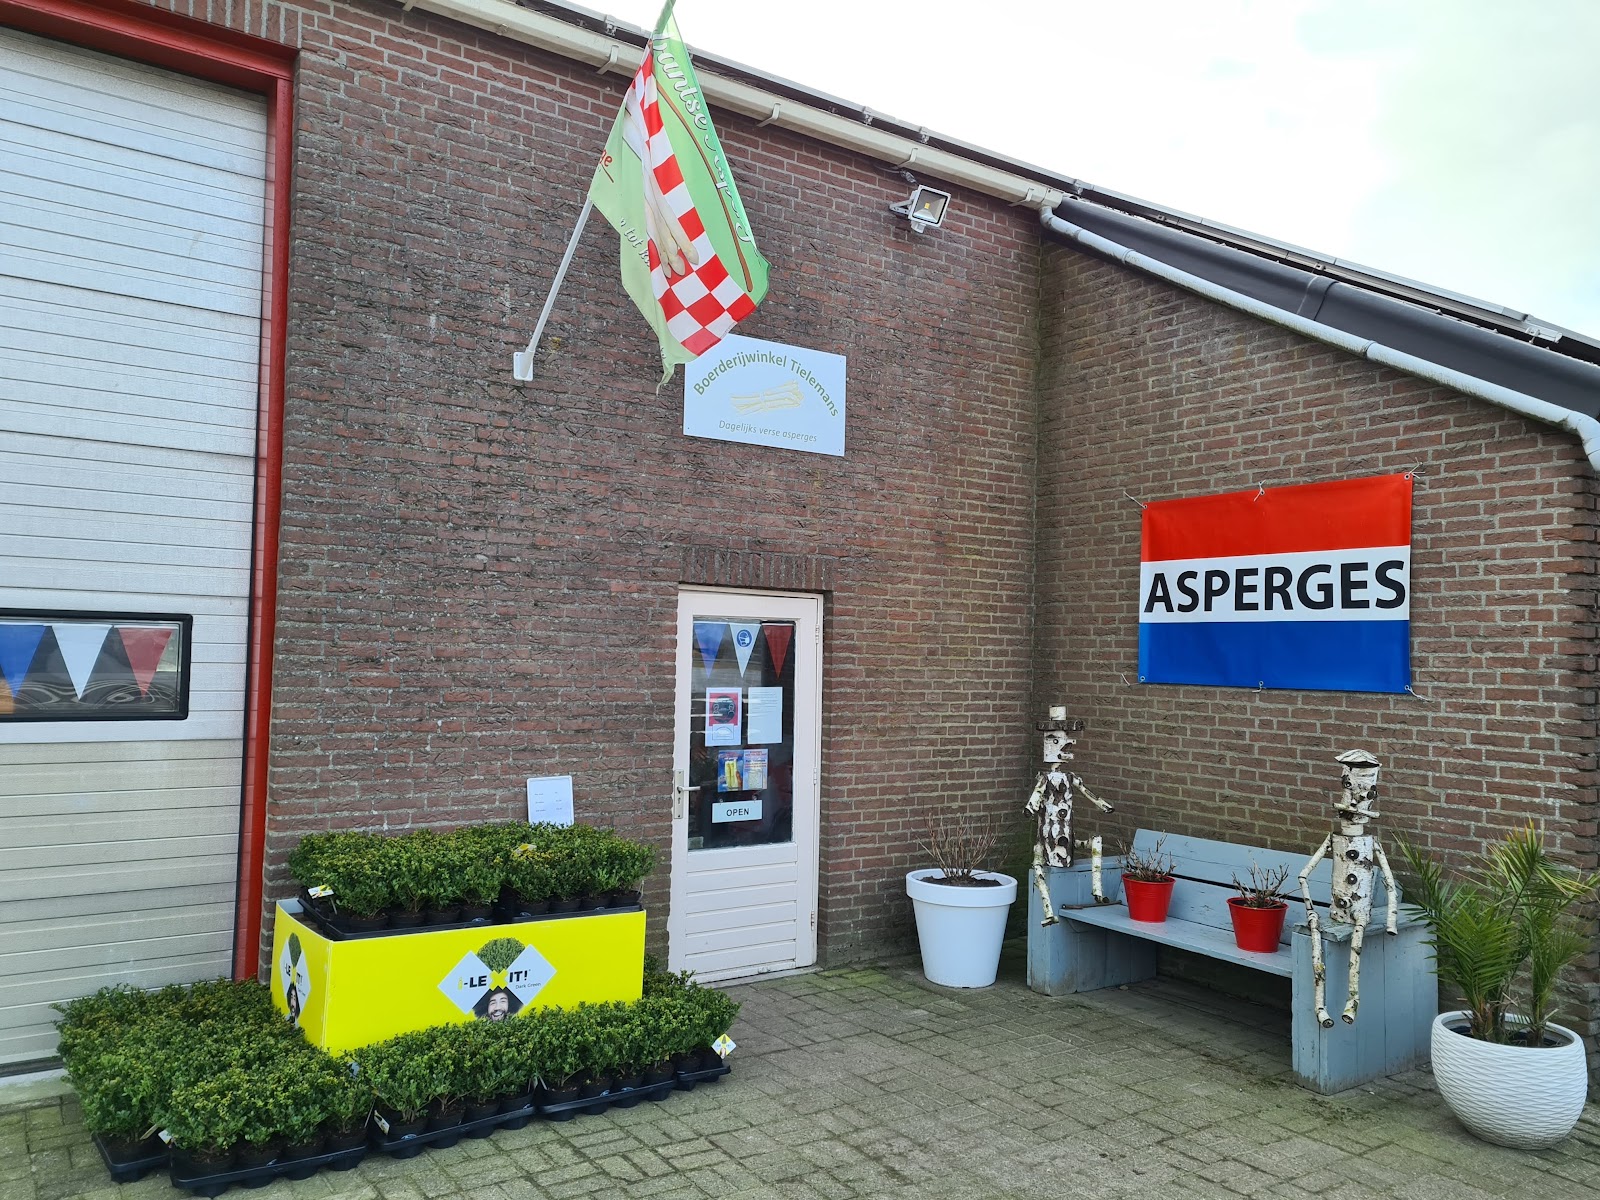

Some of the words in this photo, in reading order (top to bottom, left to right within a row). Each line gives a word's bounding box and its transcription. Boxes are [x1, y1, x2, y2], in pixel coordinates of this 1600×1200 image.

[693, 350, 787, 395] Boerderijwinkel
[791, 359, 838, 417] Tielemans
[719, 420, 757, 434] Dagelijks
[759, 427, 780, 437] verse
[782, 431, 817, 443] asperges
[1144, 560, 1406, 613] ASPERGES
[726, 808, 750, 817] OPEN
